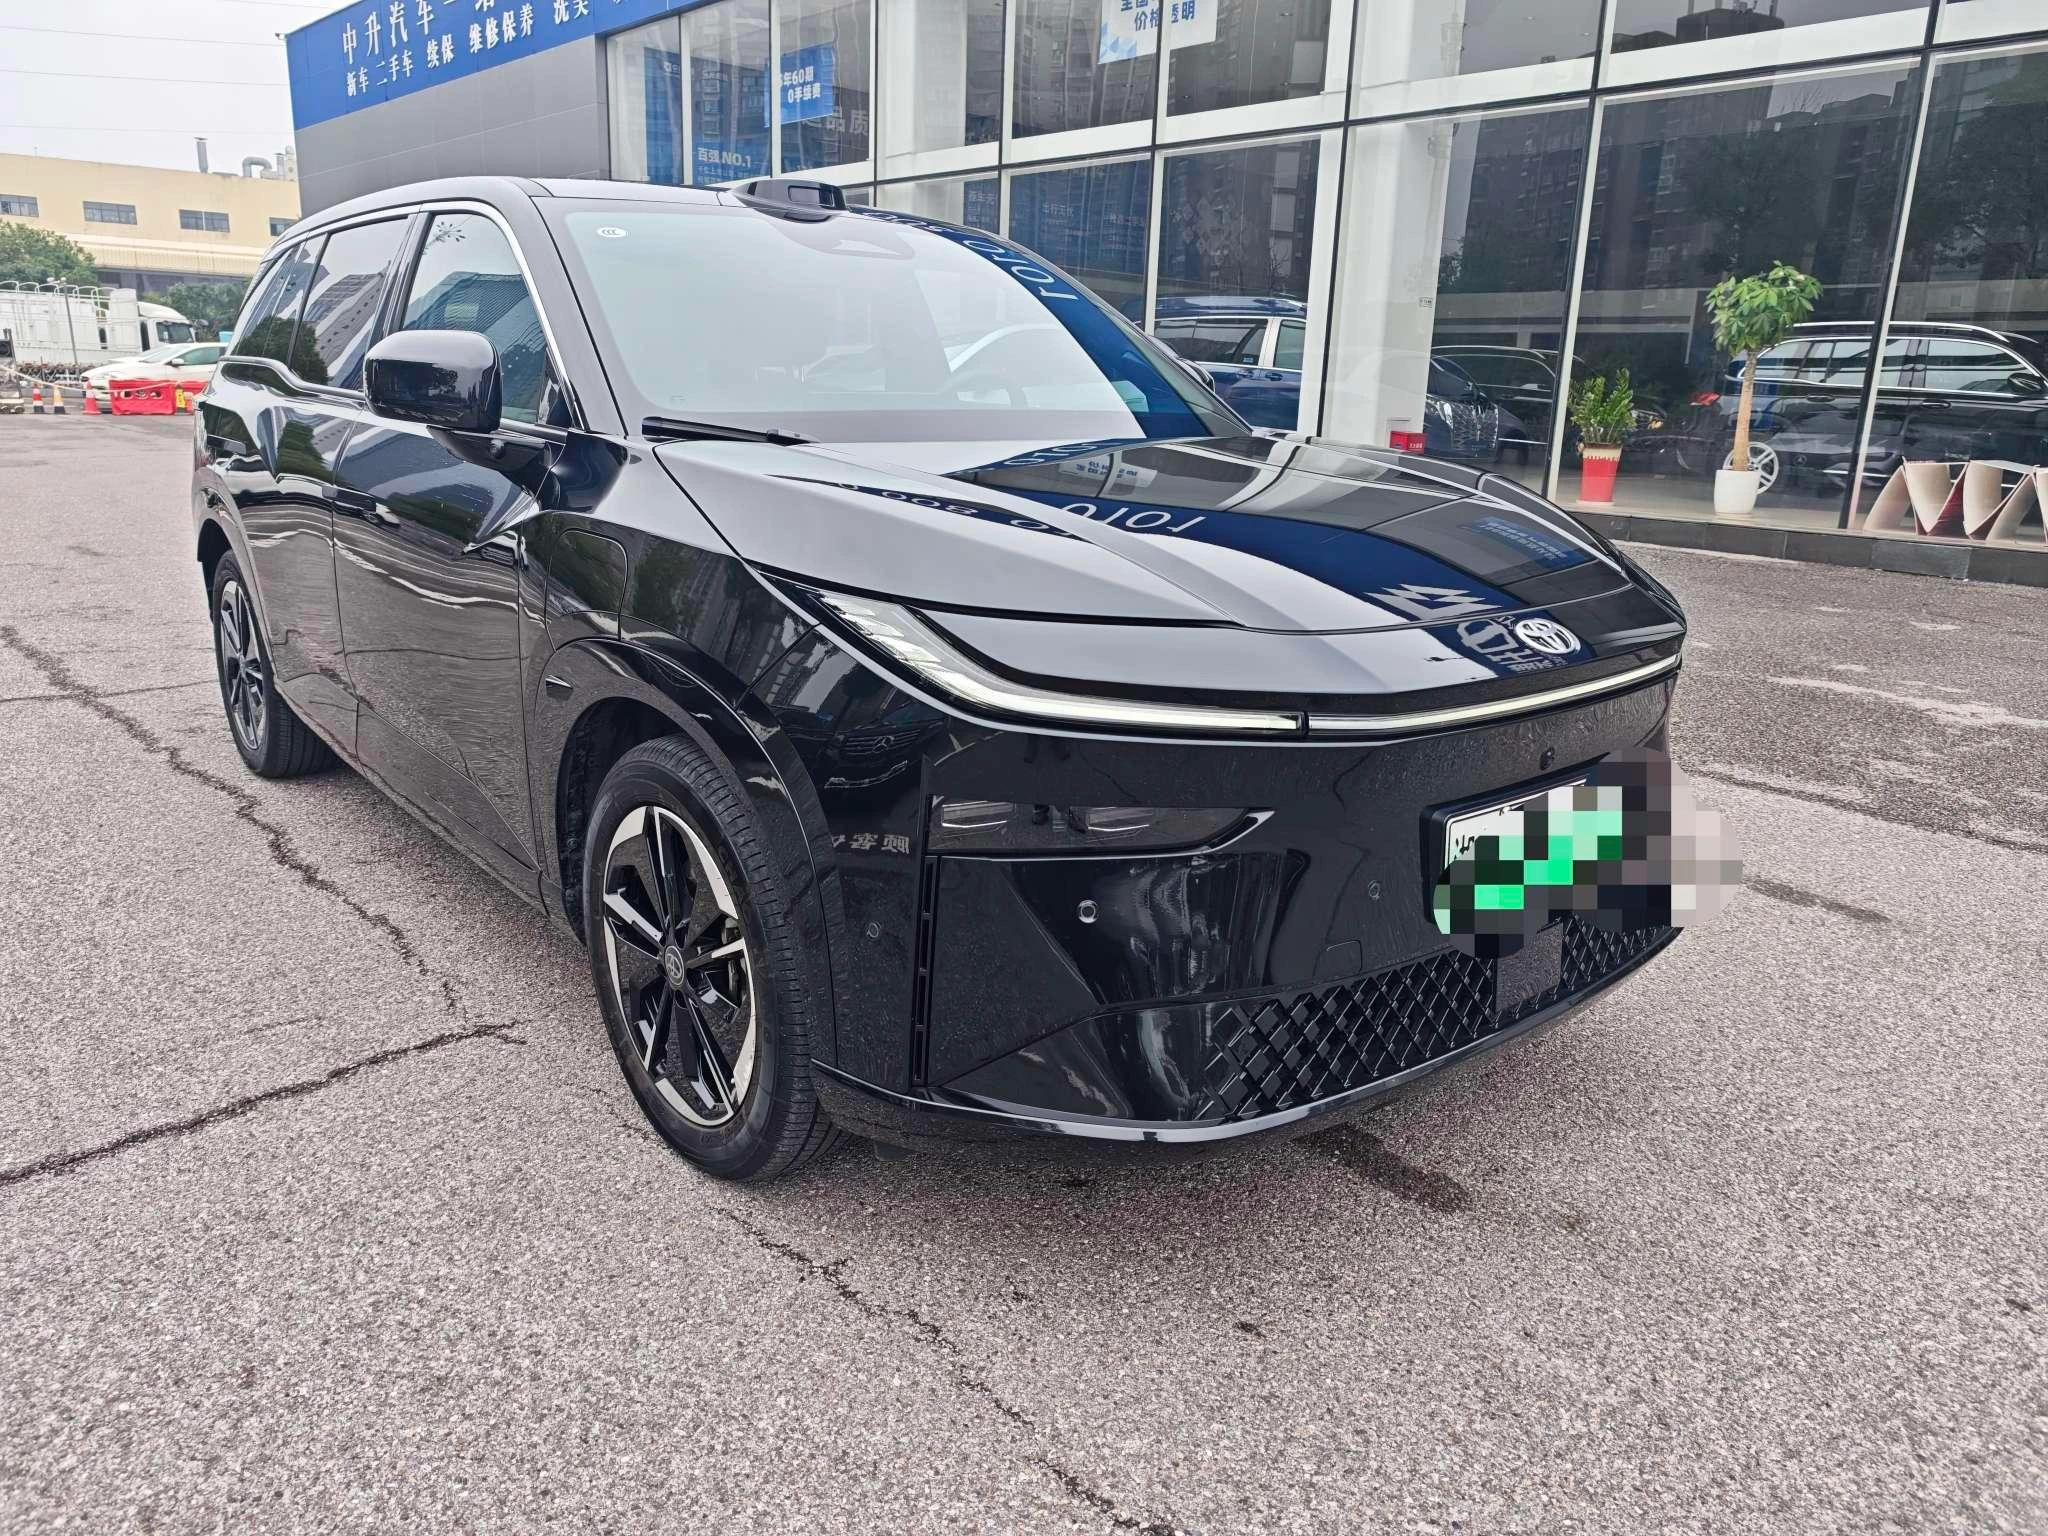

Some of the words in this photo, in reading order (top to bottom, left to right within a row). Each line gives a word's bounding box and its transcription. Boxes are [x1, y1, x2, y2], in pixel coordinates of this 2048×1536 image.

[346, 66, 369, 97] 新车
[375, 49, 414, 85] 二手车
[427, 33, 455, 68] 续保
[469, 3, 534, 54] 维修保养
